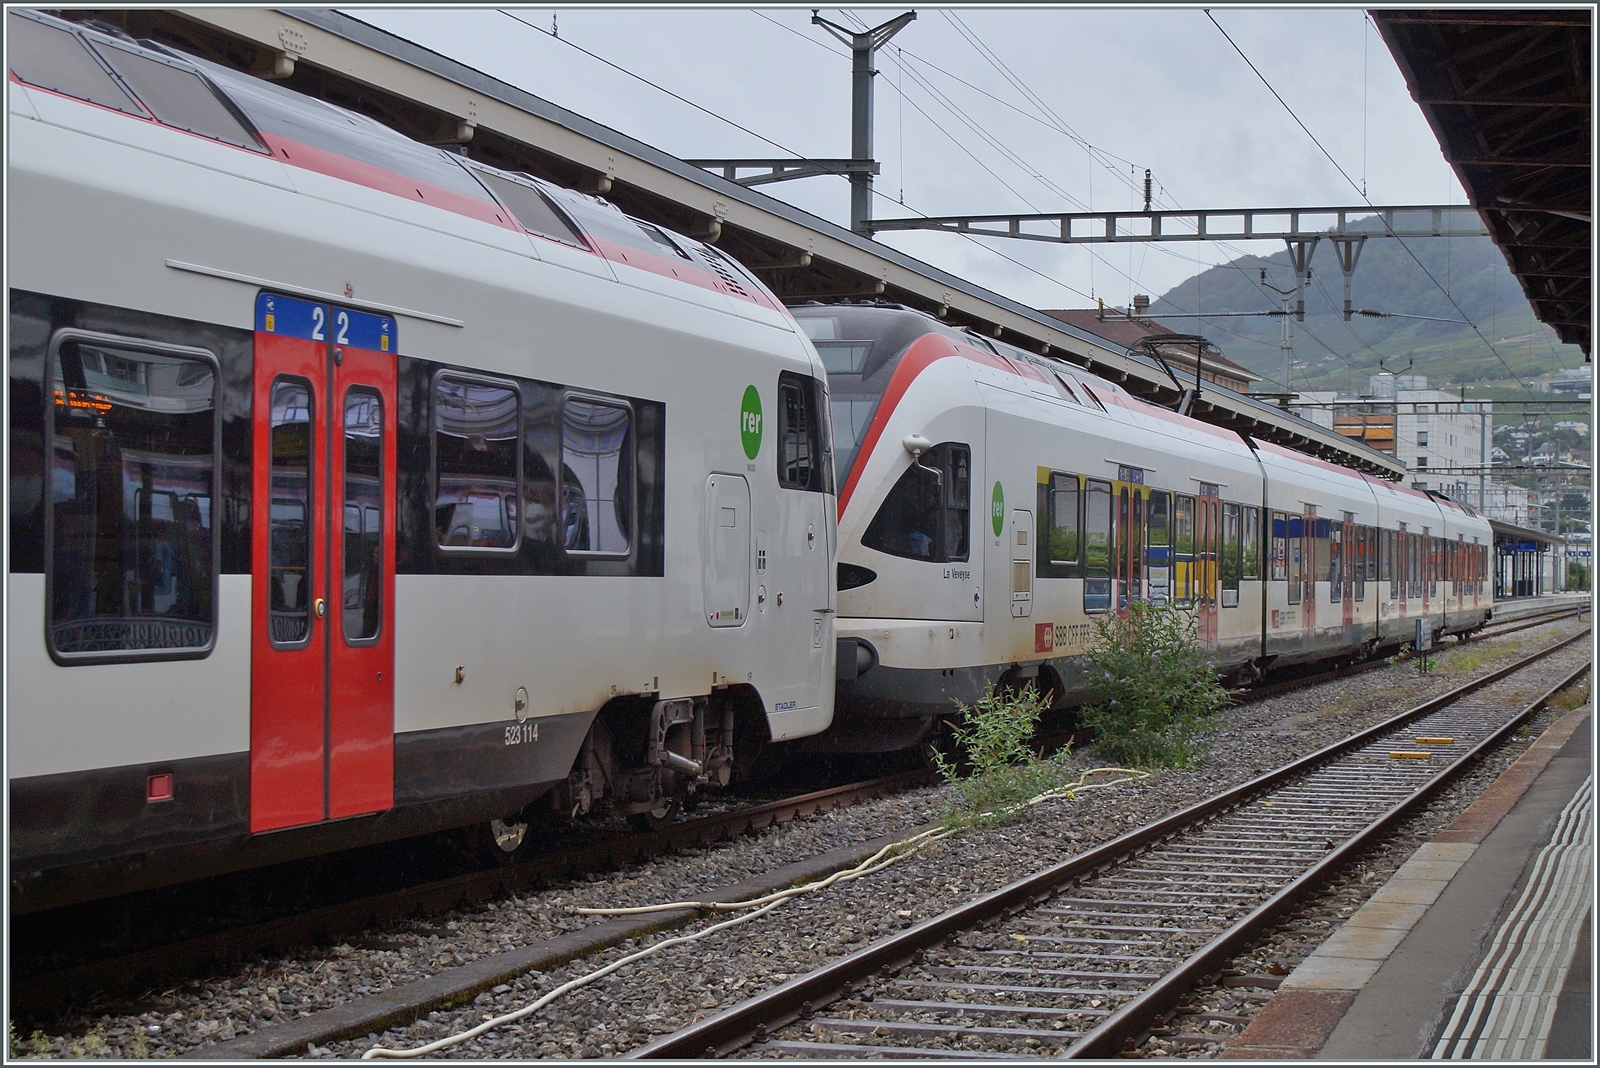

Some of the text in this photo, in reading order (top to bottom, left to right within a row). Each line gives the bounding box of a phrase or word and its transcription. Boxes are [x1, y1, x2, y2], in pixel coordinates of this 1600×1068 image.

[312, 306, 324, 341] 2
[336, 311, 349, 345] 2
[742, 411, 761, 434] rer
[992, 501, 1004, 517] rer
[943, 567, 971, 581] La Veveyse
[1054, 623, 1091, 647] SBB CFF FFS
[774, 700, 797, 711] STADLER
[505, 723, 539, 745] 523 114
